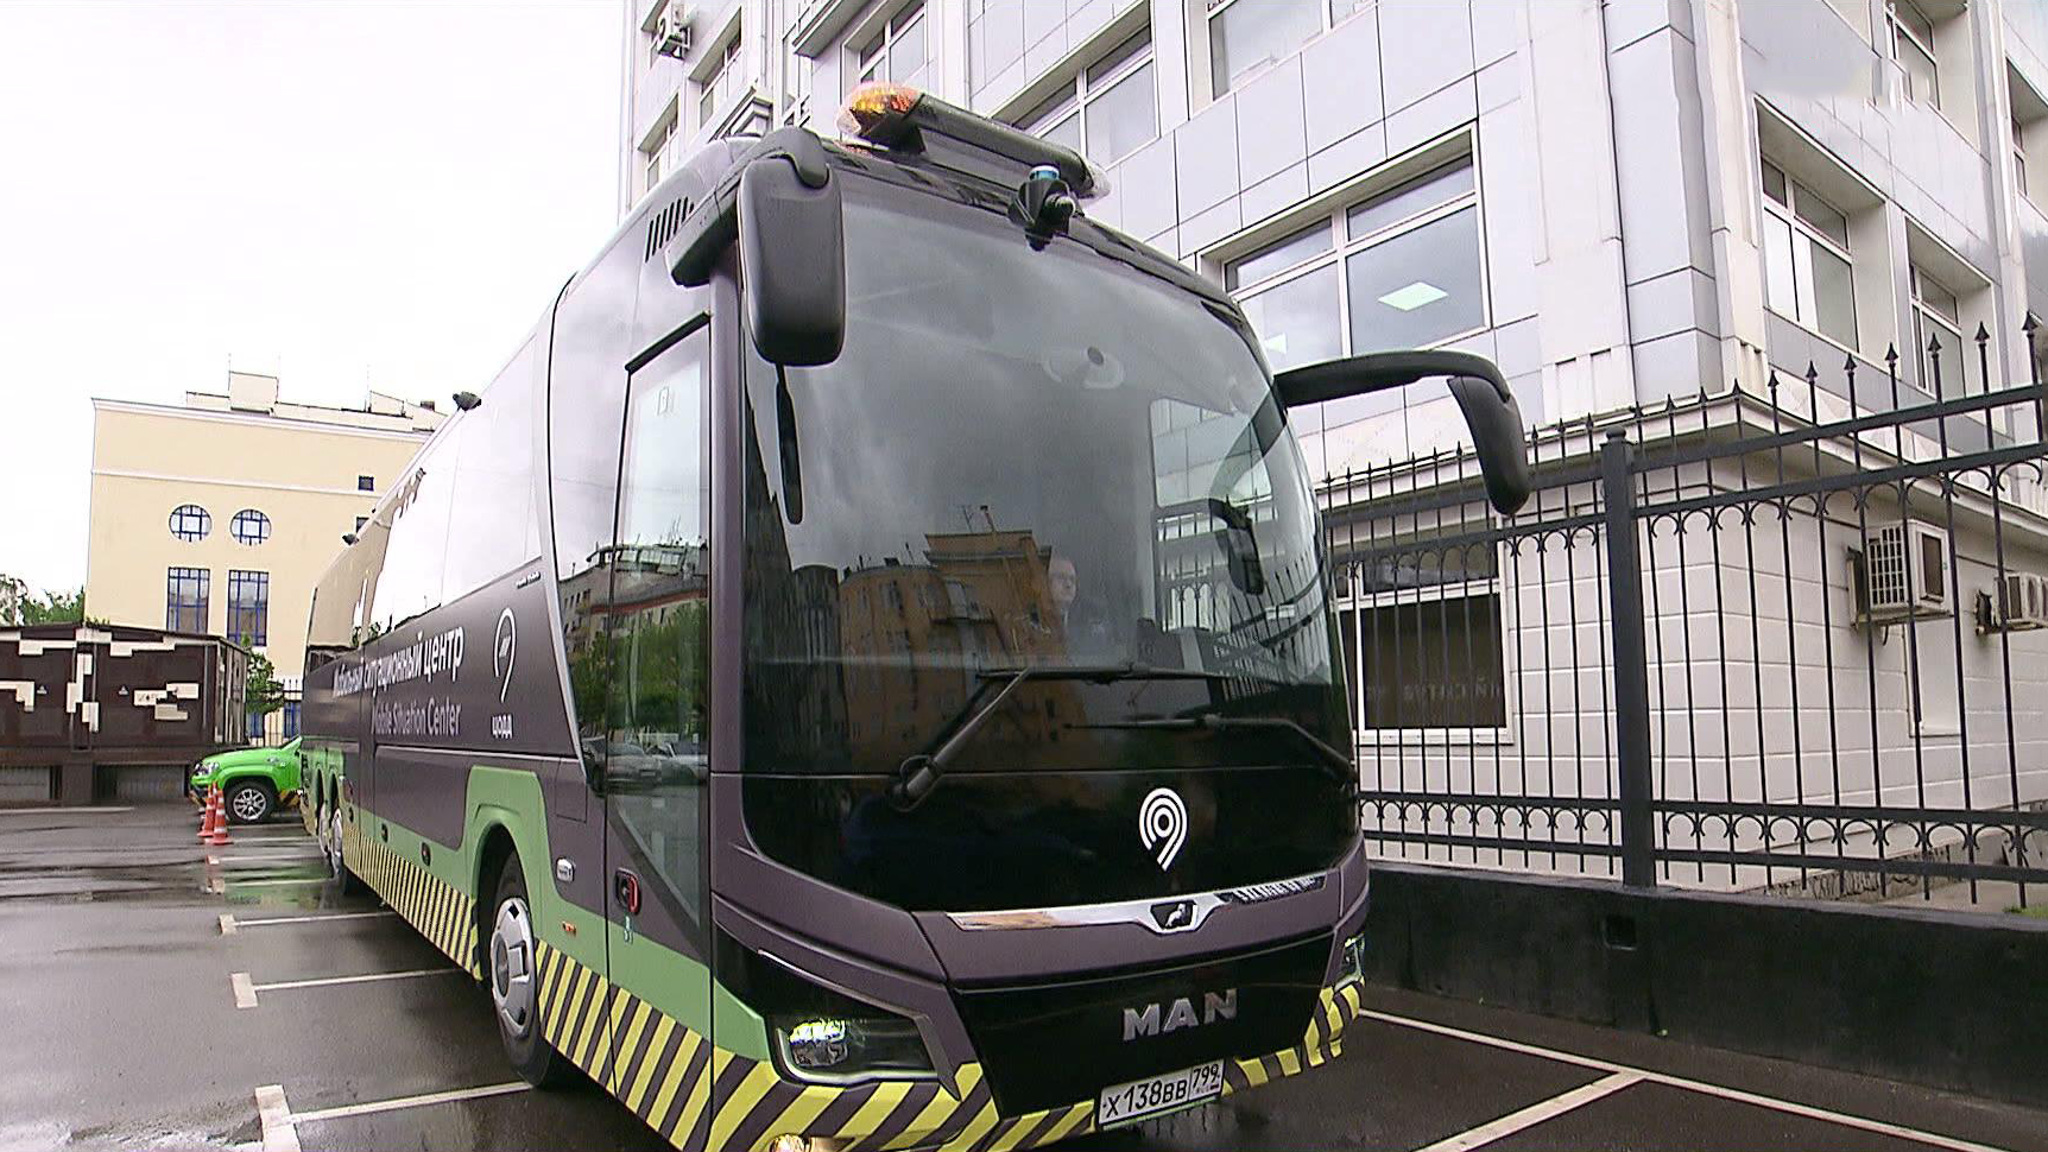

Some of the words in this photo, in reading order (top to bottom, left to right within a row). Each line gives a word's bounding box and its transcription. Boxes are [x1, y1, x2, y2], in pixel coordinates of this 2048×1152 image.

[424, 626, 463, 682] центр
[428, 696, 461, 735] Center
[492, 714, 513, 739] ЦОДД
[1122, 988, 1238, 1042] MAN
